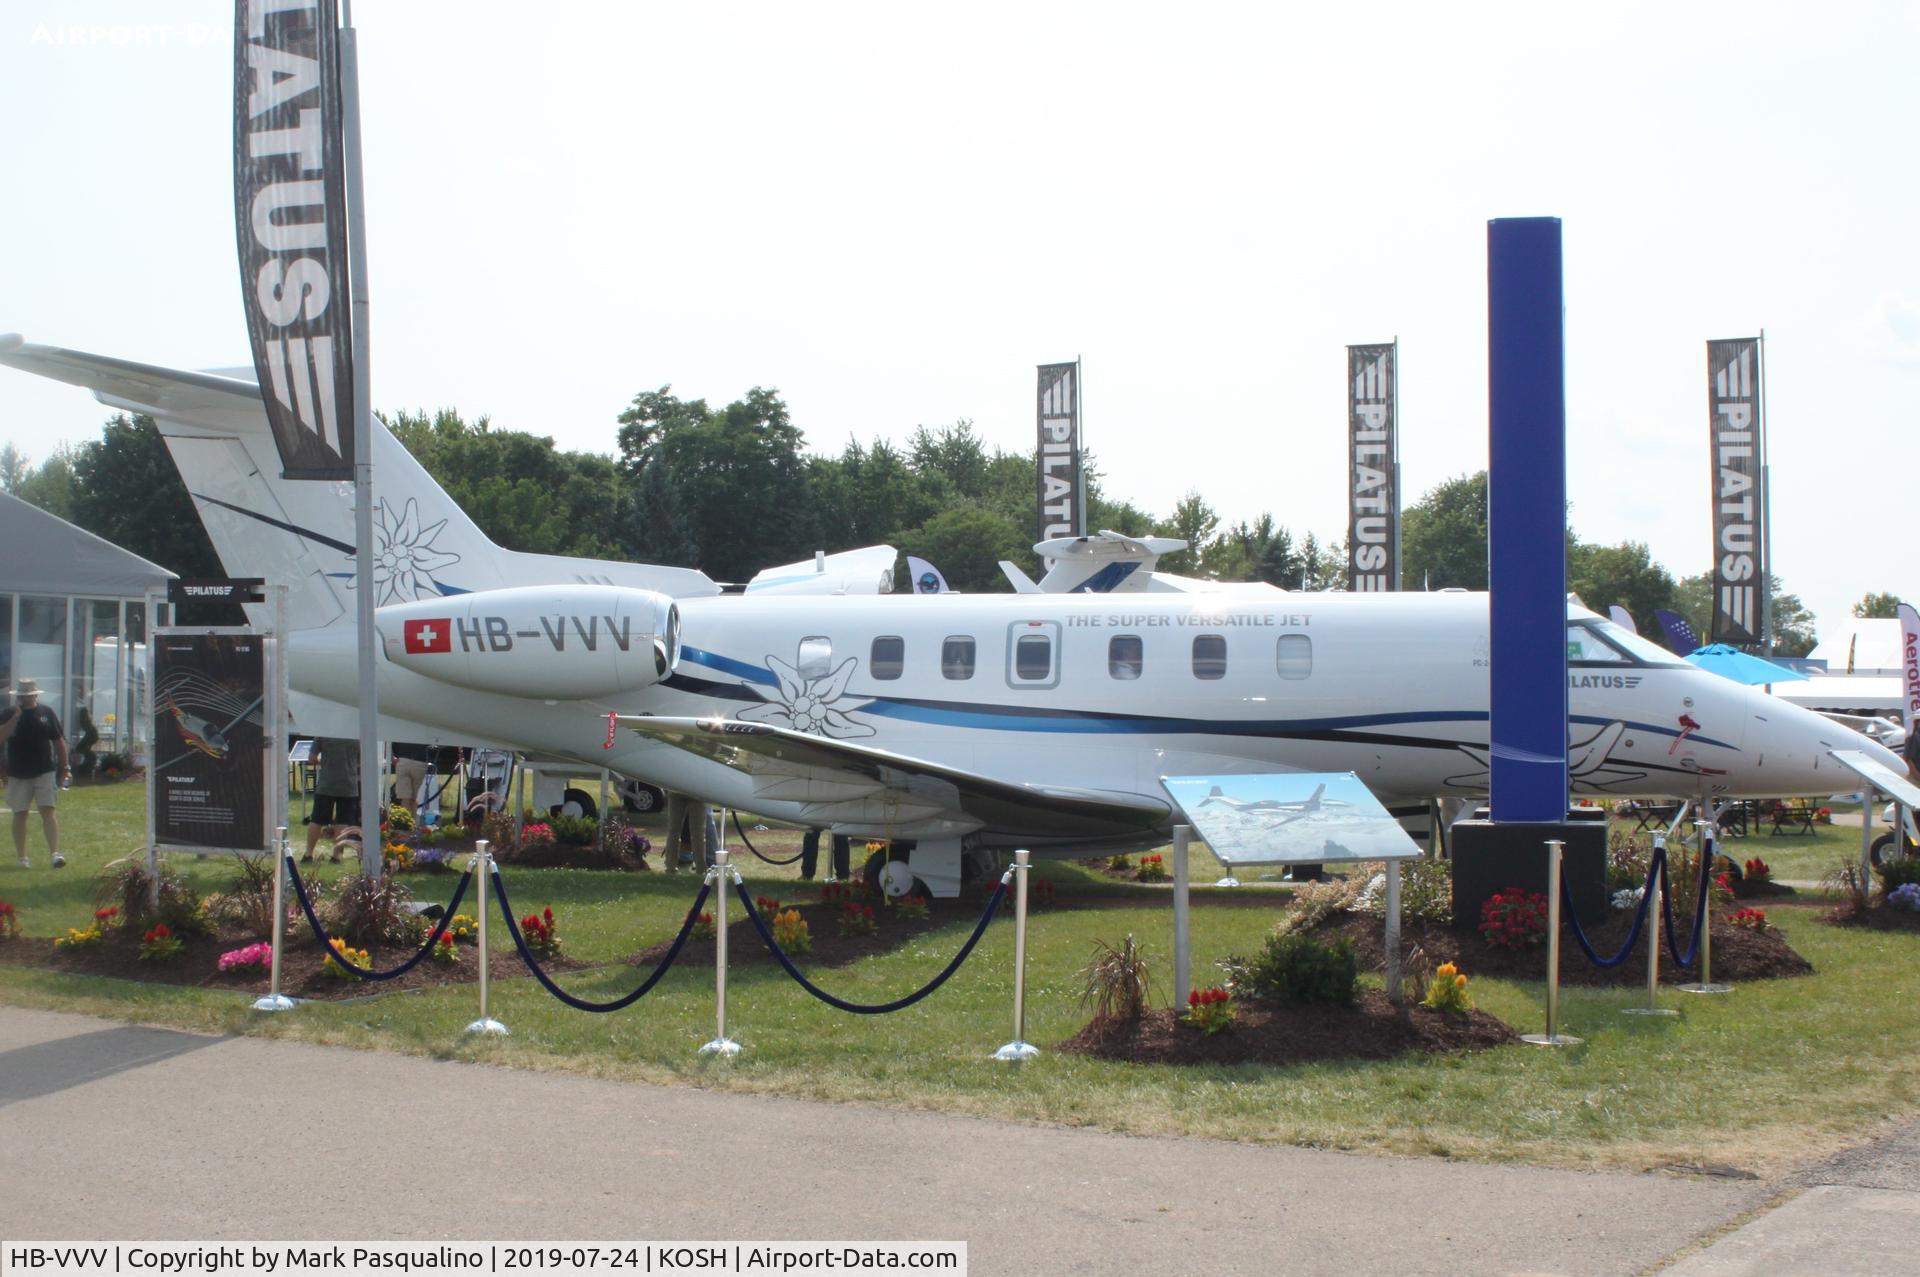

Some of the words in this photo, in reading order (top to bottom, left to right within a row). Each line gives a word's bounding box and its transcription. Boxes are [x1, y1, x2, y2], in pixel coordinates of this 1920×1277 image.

[1354, 404, 1387, 571] PILATUS
[1719, 402, 1754, 581] PILATUS
[193, 586, 224, 595] PILATUS
[456, 615, 631, 653] HB-VVV
[1066, 615, 1101, 627] THE
[1107, 615, 1170, 627] SUPER
[1176, 614, 1275, 626] VERSATILE
[1280, 614, 1313, 626] JET
